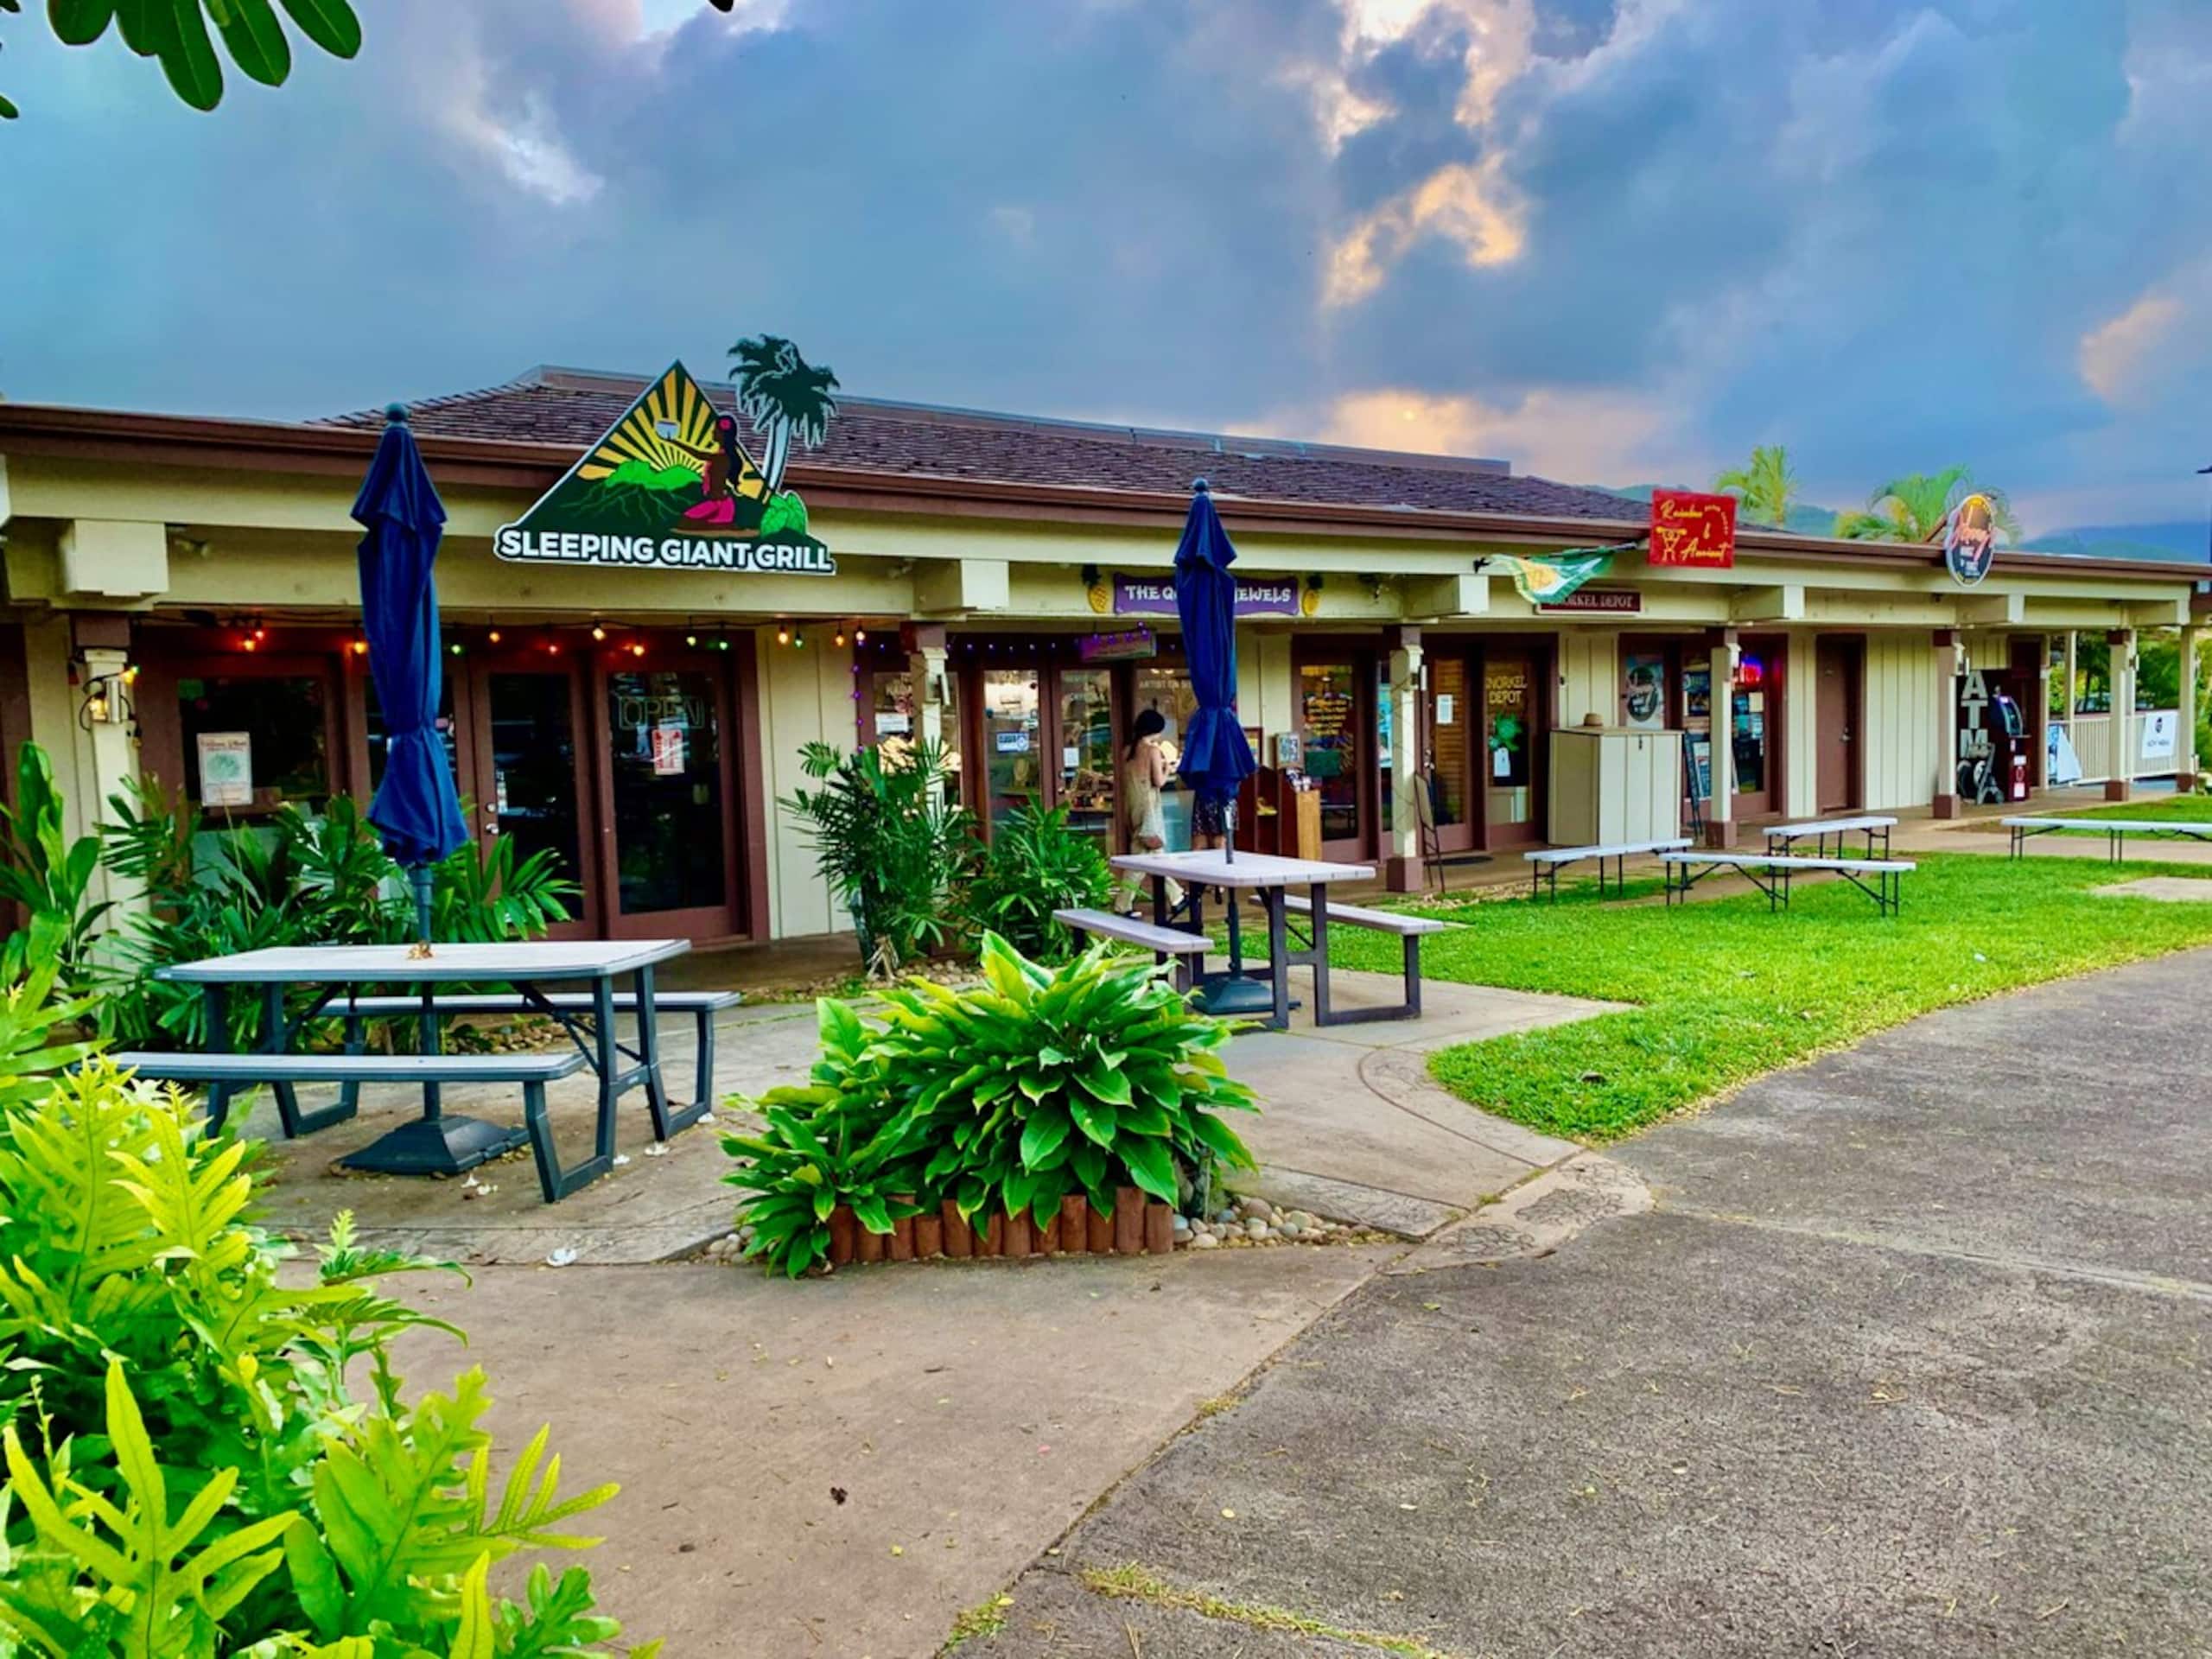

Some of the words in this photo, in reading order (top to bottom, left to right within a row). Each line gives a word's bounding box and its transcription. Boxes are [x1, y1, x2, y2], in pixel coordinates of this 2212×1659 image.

[501, 531, 655, 562] SLEEPING
[661, 538, 752, 567] GIANT
[754, 544, 833, 570] GRILL
[1124, 585, 1160, 601] THE
[1600, 594, 1634, 608] DEPOT
[1489, 690, 1522, 704] DEPOT
[622, 696, 704, 727] OPEN
[1960, 670, 1988, 759] ATM
